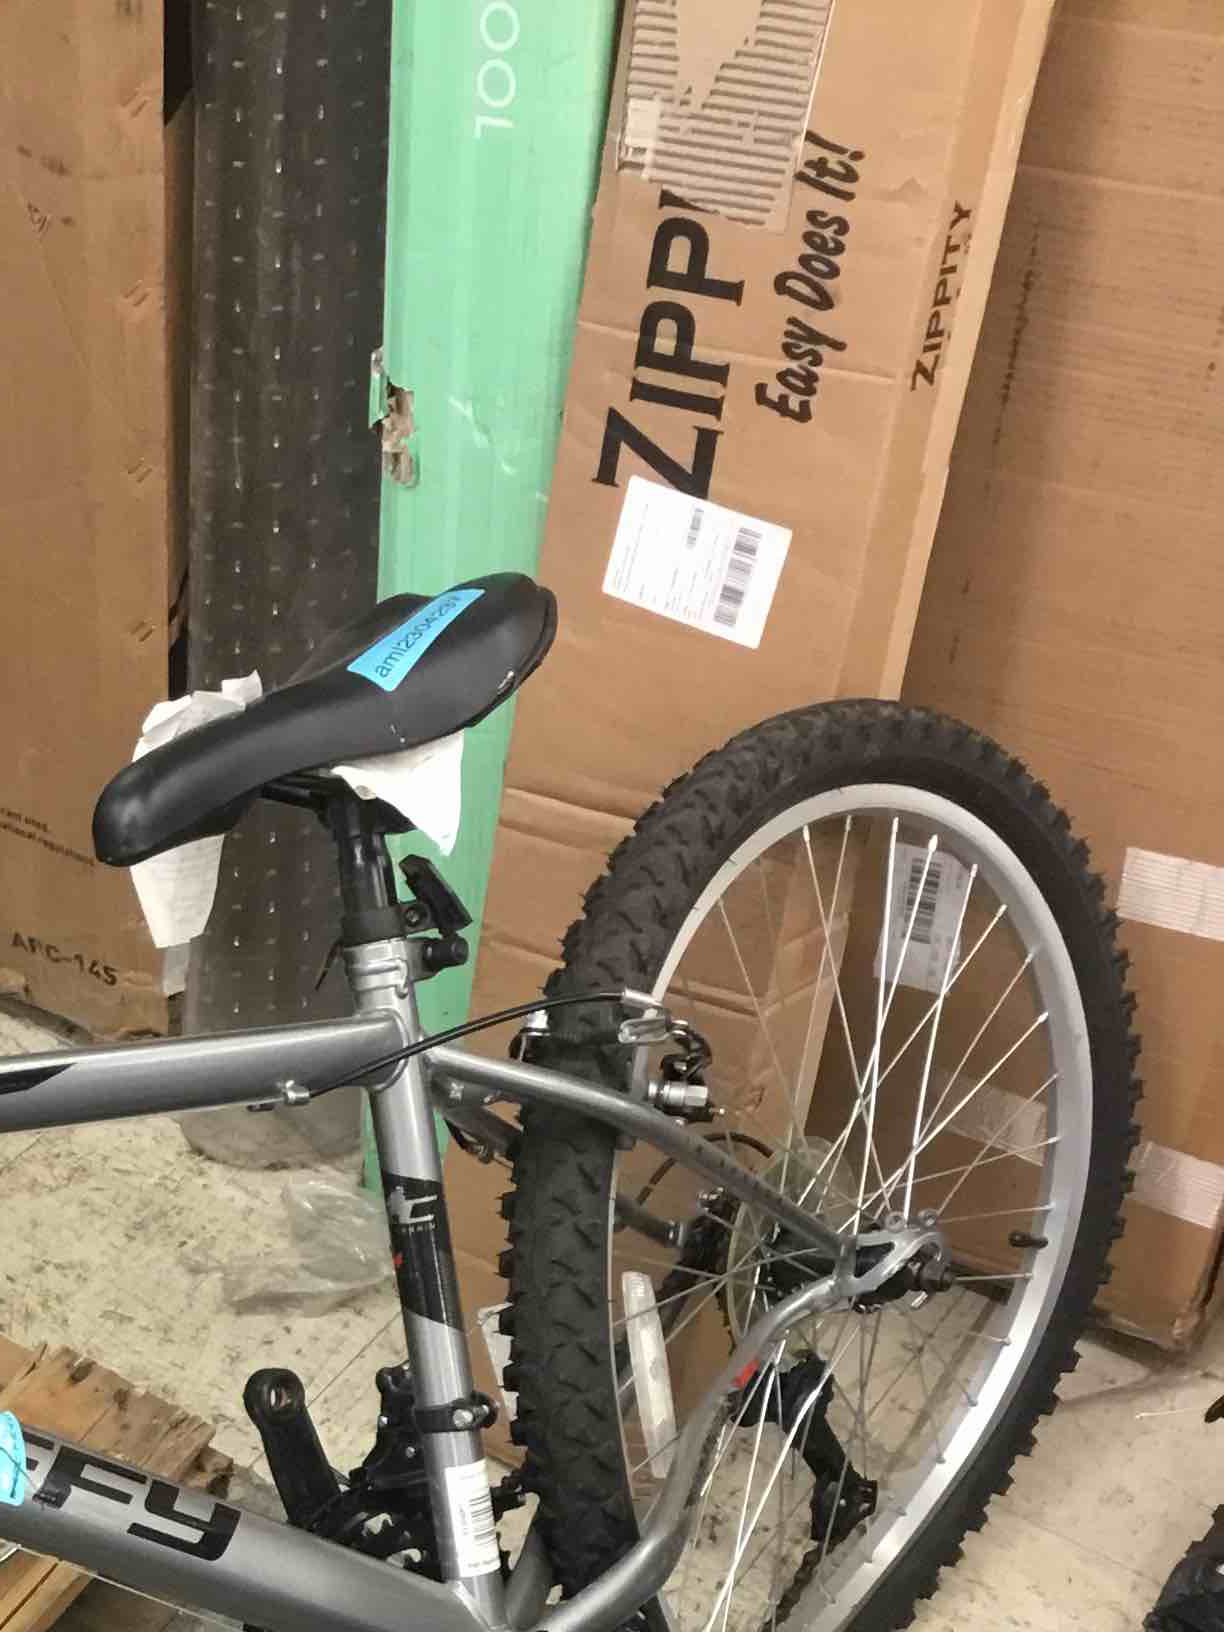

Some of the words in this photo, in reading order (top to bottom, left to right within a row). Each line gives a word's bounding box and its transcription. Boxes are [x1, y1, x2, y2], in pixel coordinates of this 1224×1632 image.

[795, 130, 865, 201] It!
[774, 210, 850, 311] Does
[911, 200, 976, 392] ZIPPITY
[755, 316, 847, 423] Easy
